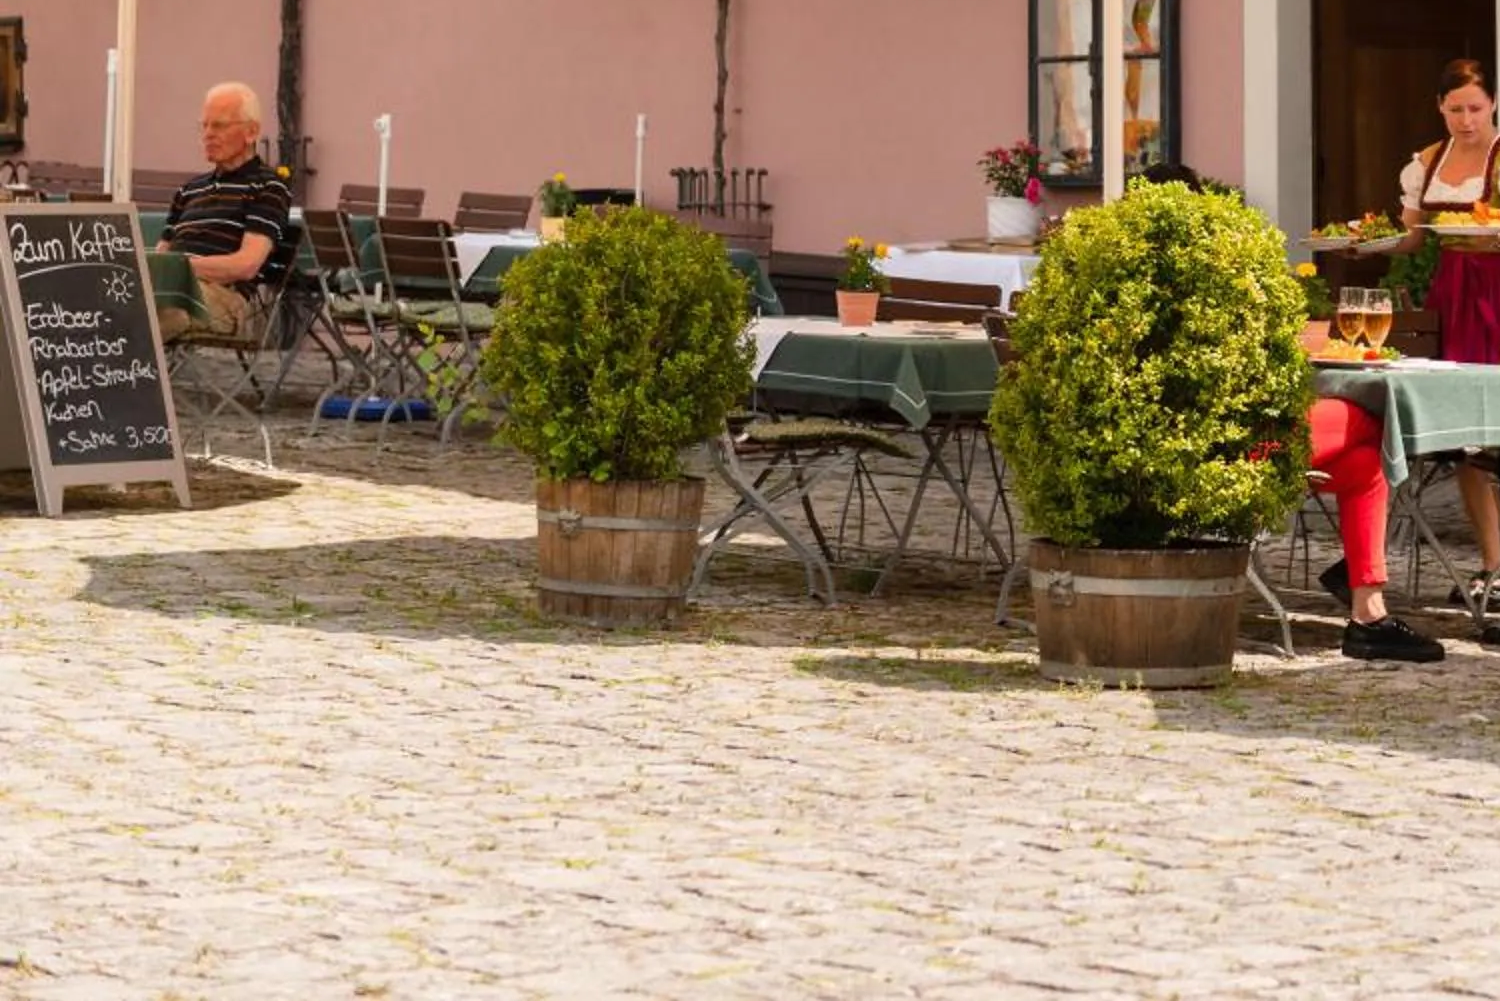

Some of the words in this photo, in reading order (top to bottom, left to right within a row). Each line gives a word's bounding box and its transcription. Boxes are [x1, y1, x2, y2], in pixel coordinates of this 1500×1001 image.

[10, 222, 65, 263] Zum
[68, 220, 134, 262] Kaffee
[28, 335, 128, 360] Rhabarber
[44, 400, 105, 426] Kuchen
